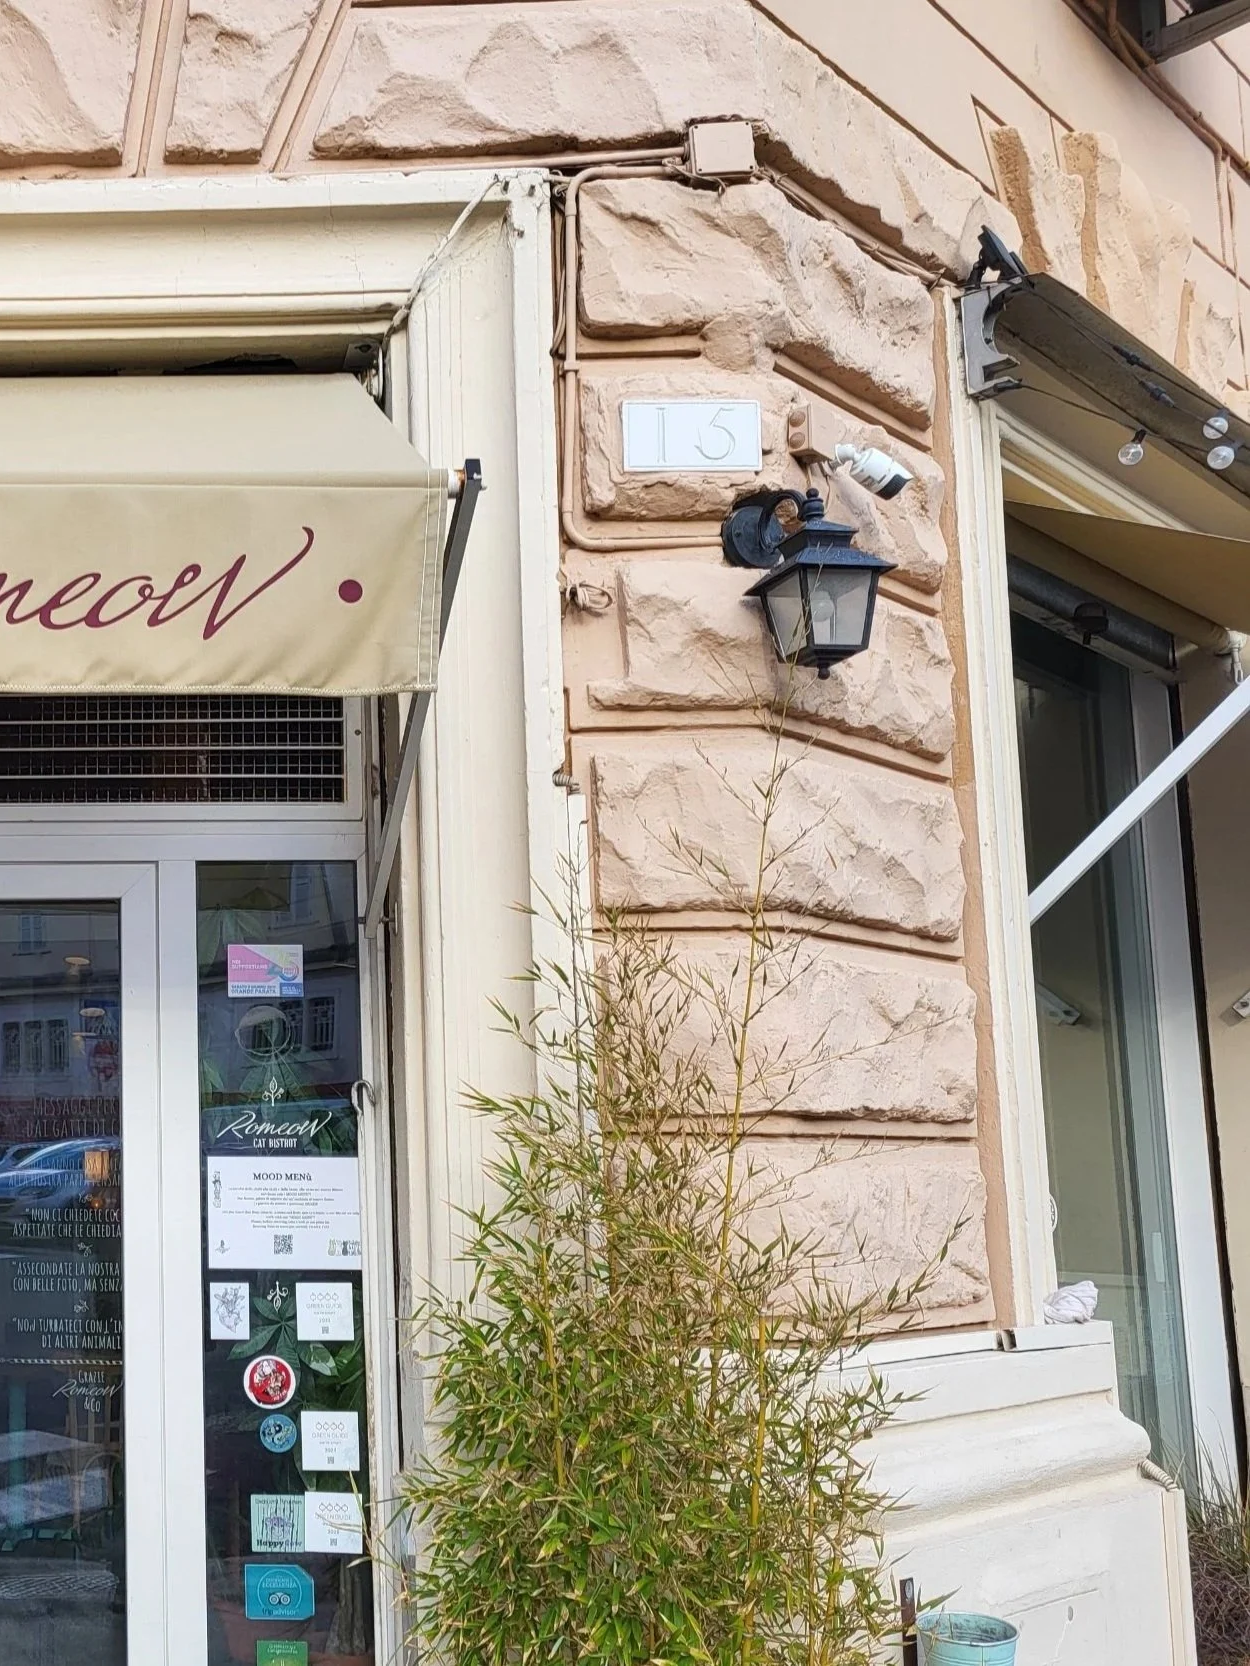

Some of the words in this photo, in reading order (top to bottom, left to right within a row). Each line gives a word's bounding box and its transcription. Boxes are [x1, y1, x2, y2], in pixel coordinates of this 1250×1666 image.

[253, 1137, 266, 1148] CAT
[268, 1138, 298, 1148] BISTROT
[253, 1172, 283, 1181] MOOD
[52, 1207, 62, 1222] CI
[64, 1207, 103, 1222] CHIEDETE
[12, 1223, 56, 1238] ASPETTATE
[58, 1223, 73, 1238] CHE
[75, 1224, 84, 1238] LE
[75, 1262, 86, 1276] LA
[88, 1262, 120, 1276] NOSTRA
[13, 1277, 30, 1291] CON
[32, 1277, 55, 1292] BELLE
[57, 1277, 82, 1293] FOTO,
[84, 1278, 98, 1292] MA
[38, 1318, 83, 1333] TURBATECI
[85, 1319, 102, 1333] CON
[41, 1334, 52, 1348] DI
[54, 1334, 79, 1349] ALTRI
[81, 1335, 122, 1350] ANIMALI
